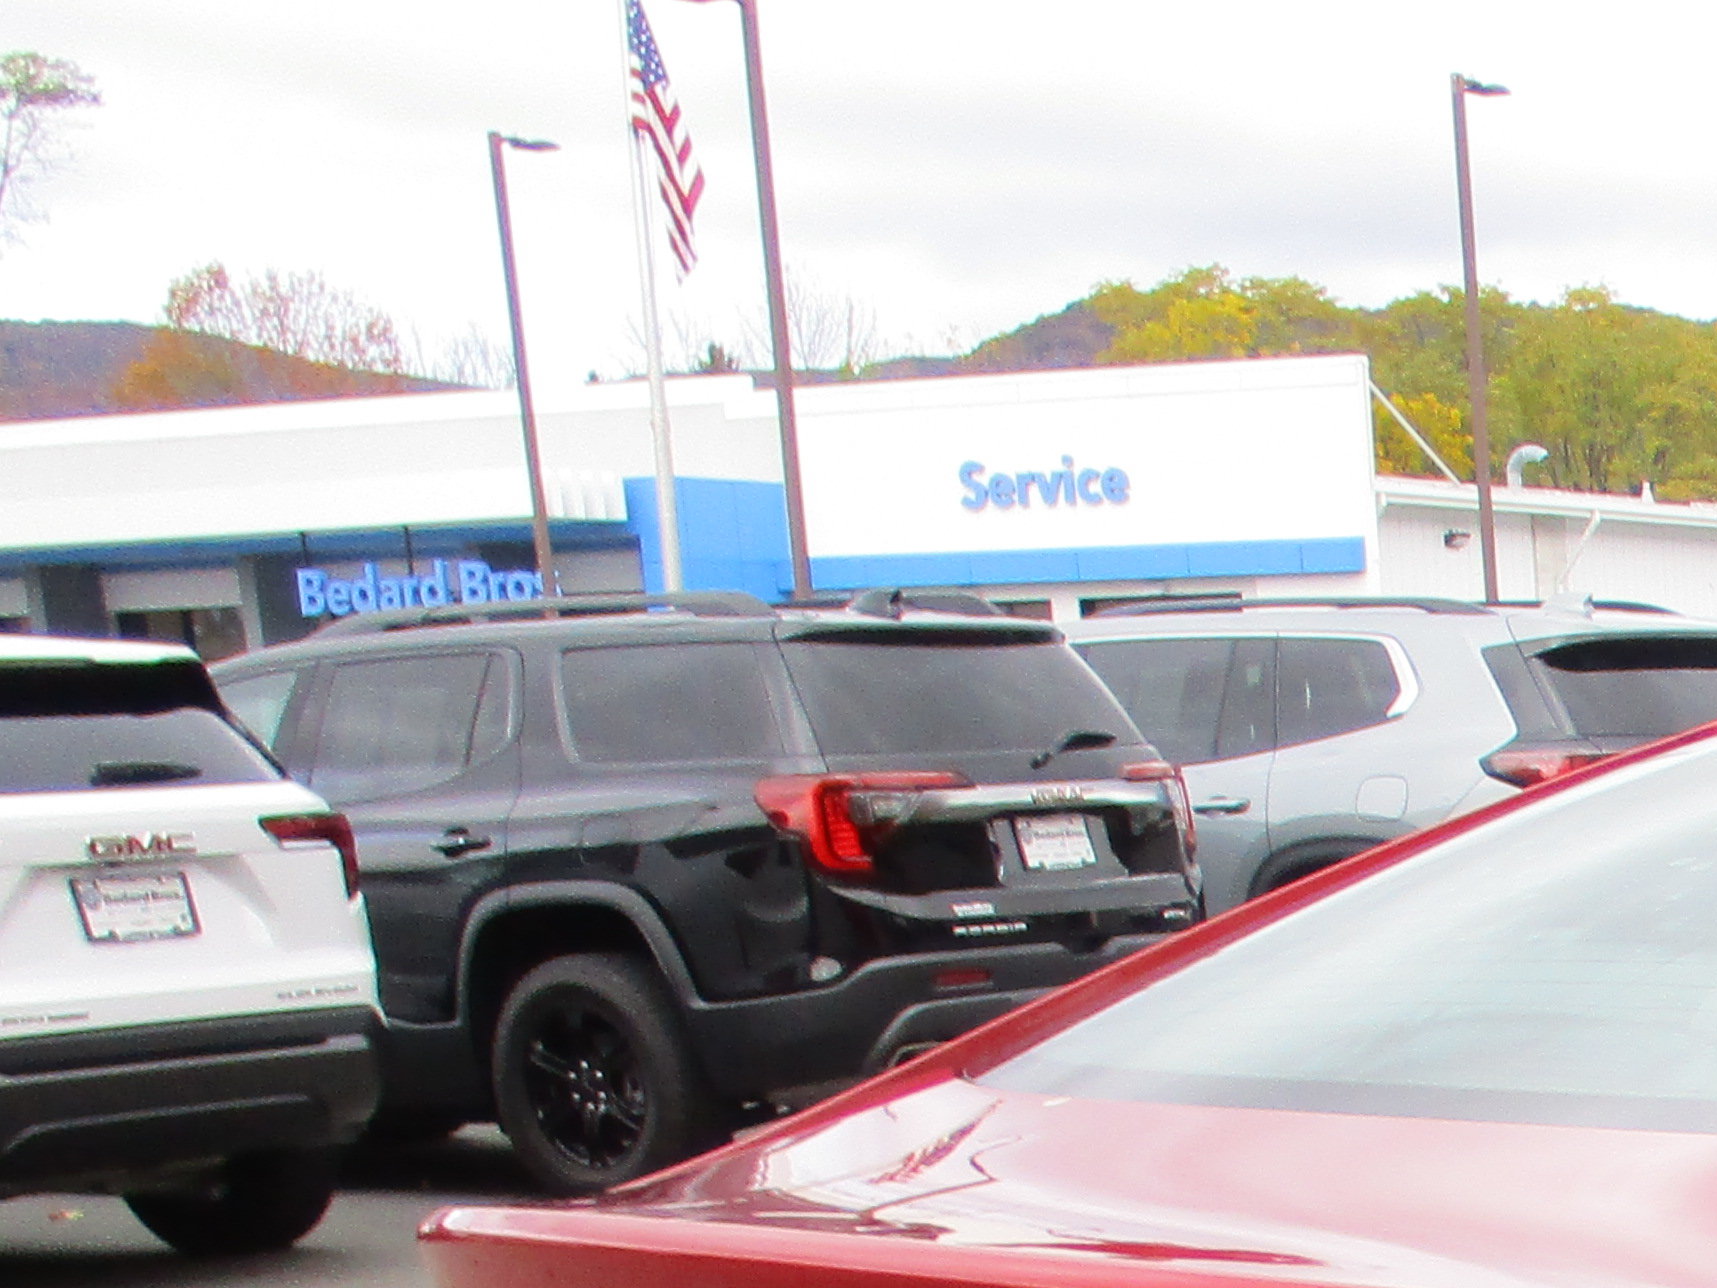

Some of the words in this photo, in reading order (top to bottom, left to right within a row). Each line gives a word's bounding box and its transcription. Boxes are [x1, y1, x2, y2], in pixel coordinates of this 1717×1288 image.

[958, 454, 1131, 512] Service
[297, 558, 449, 617] Bedard
[86, 832, 199, 861] GMC
